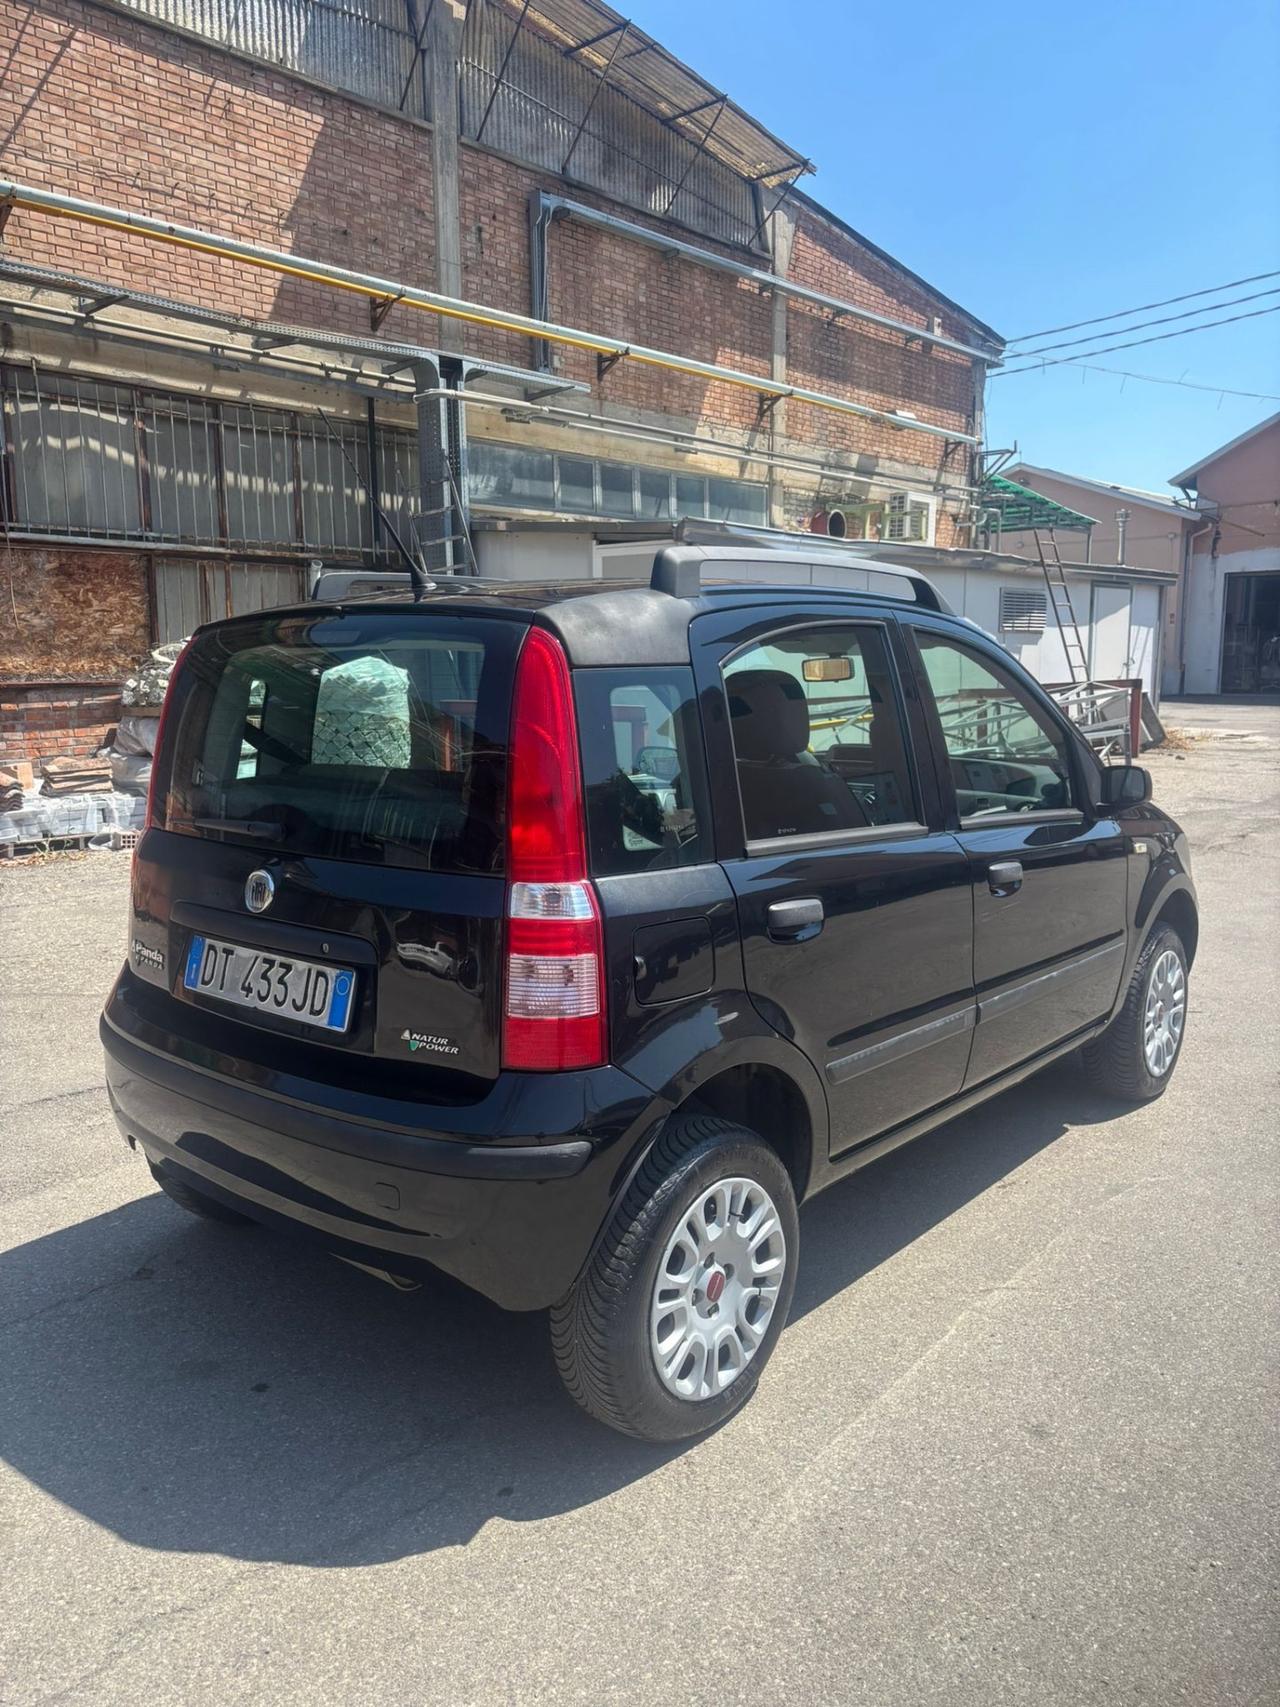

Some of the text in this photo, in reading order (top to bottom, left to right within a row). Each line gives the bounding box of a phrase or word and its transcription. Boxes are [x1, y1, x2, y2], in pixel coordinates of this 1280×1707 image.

[136, 941, 163, 963] Panda
[200, 943, 330, 1016] DT 433JD
[411, 1033, 448, 1045] NATUR
[418, 1041, 458, 1054] POWER
